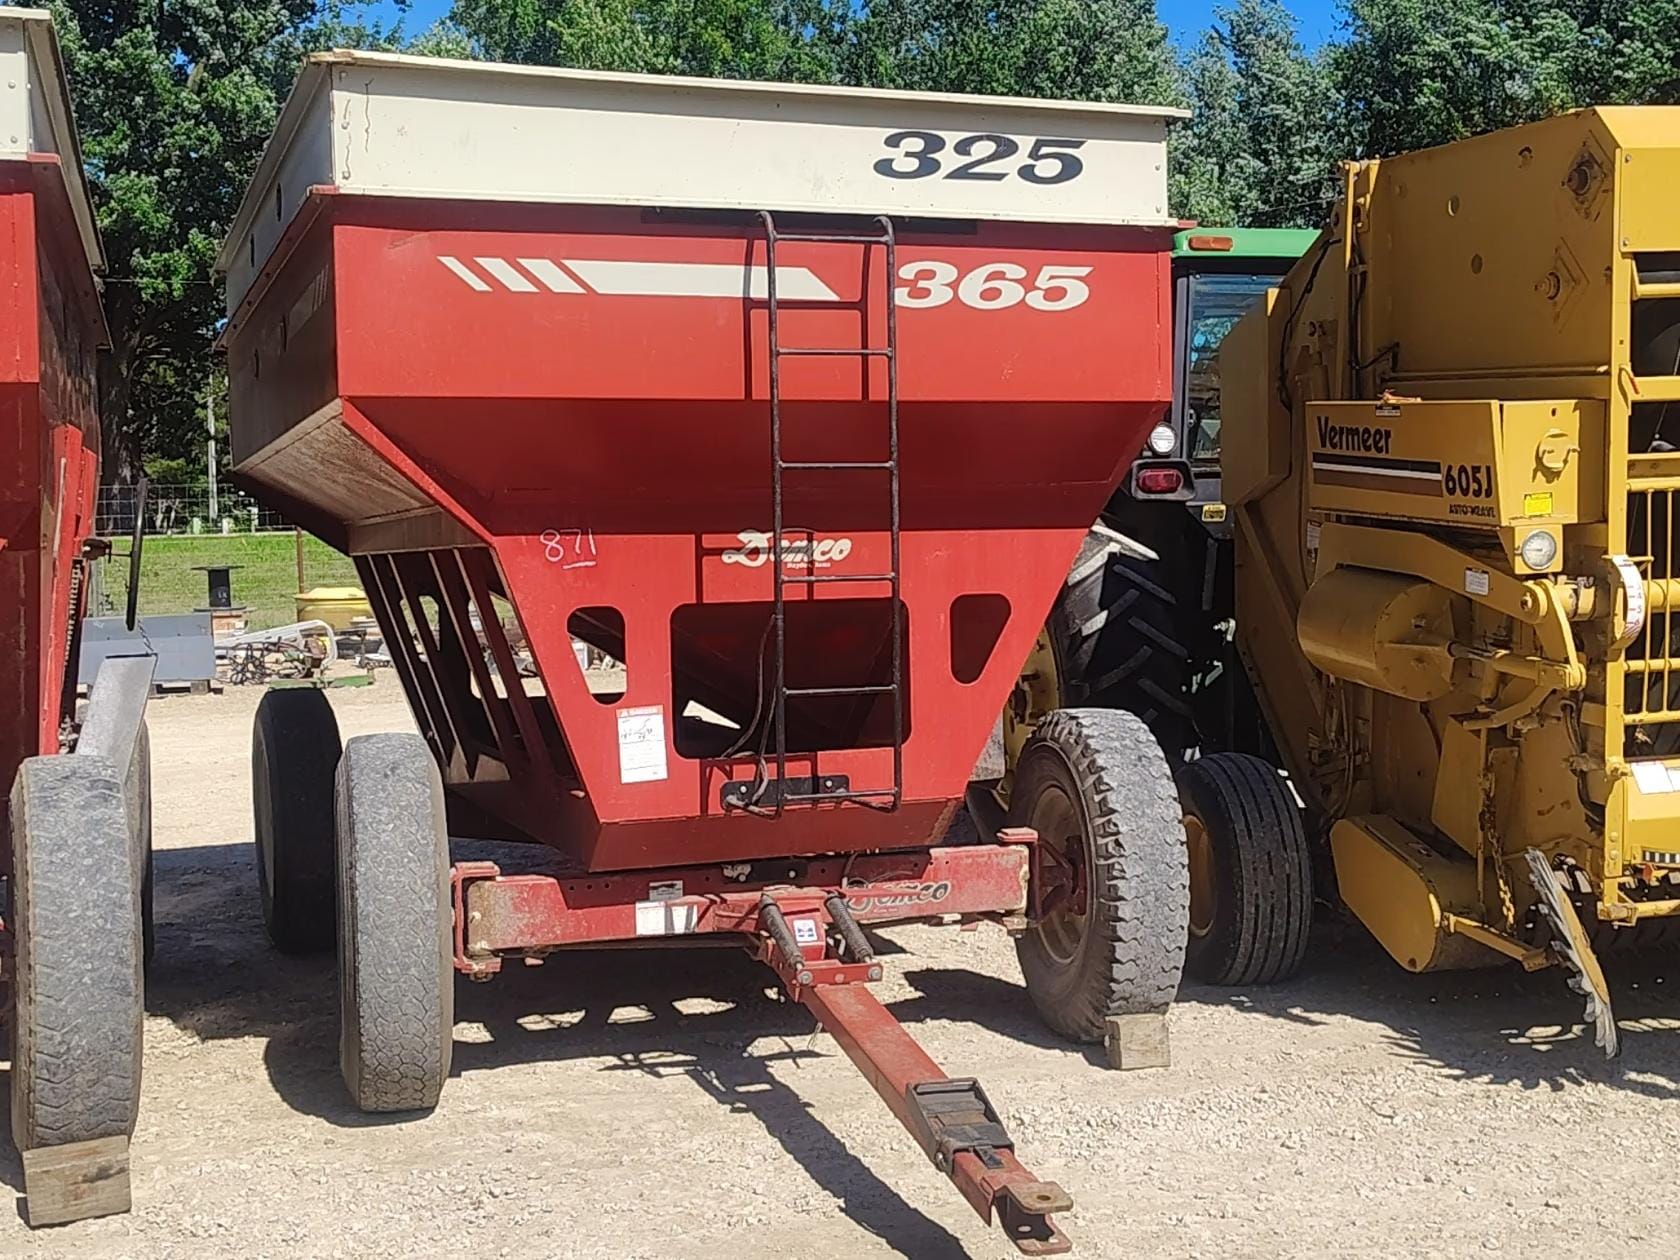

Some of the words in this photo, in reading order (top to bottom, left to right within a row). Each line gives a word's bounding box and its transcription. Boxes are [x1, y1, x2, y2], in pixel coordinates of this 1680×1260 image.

[873, 130, 1088, 185] 325
[895, 260, 1095, 311] 365
[1316, 415, 1392, 455] Vermeer
[1444, 463, 1494, 499] 605J
[539, 528, 597, 562] 871
